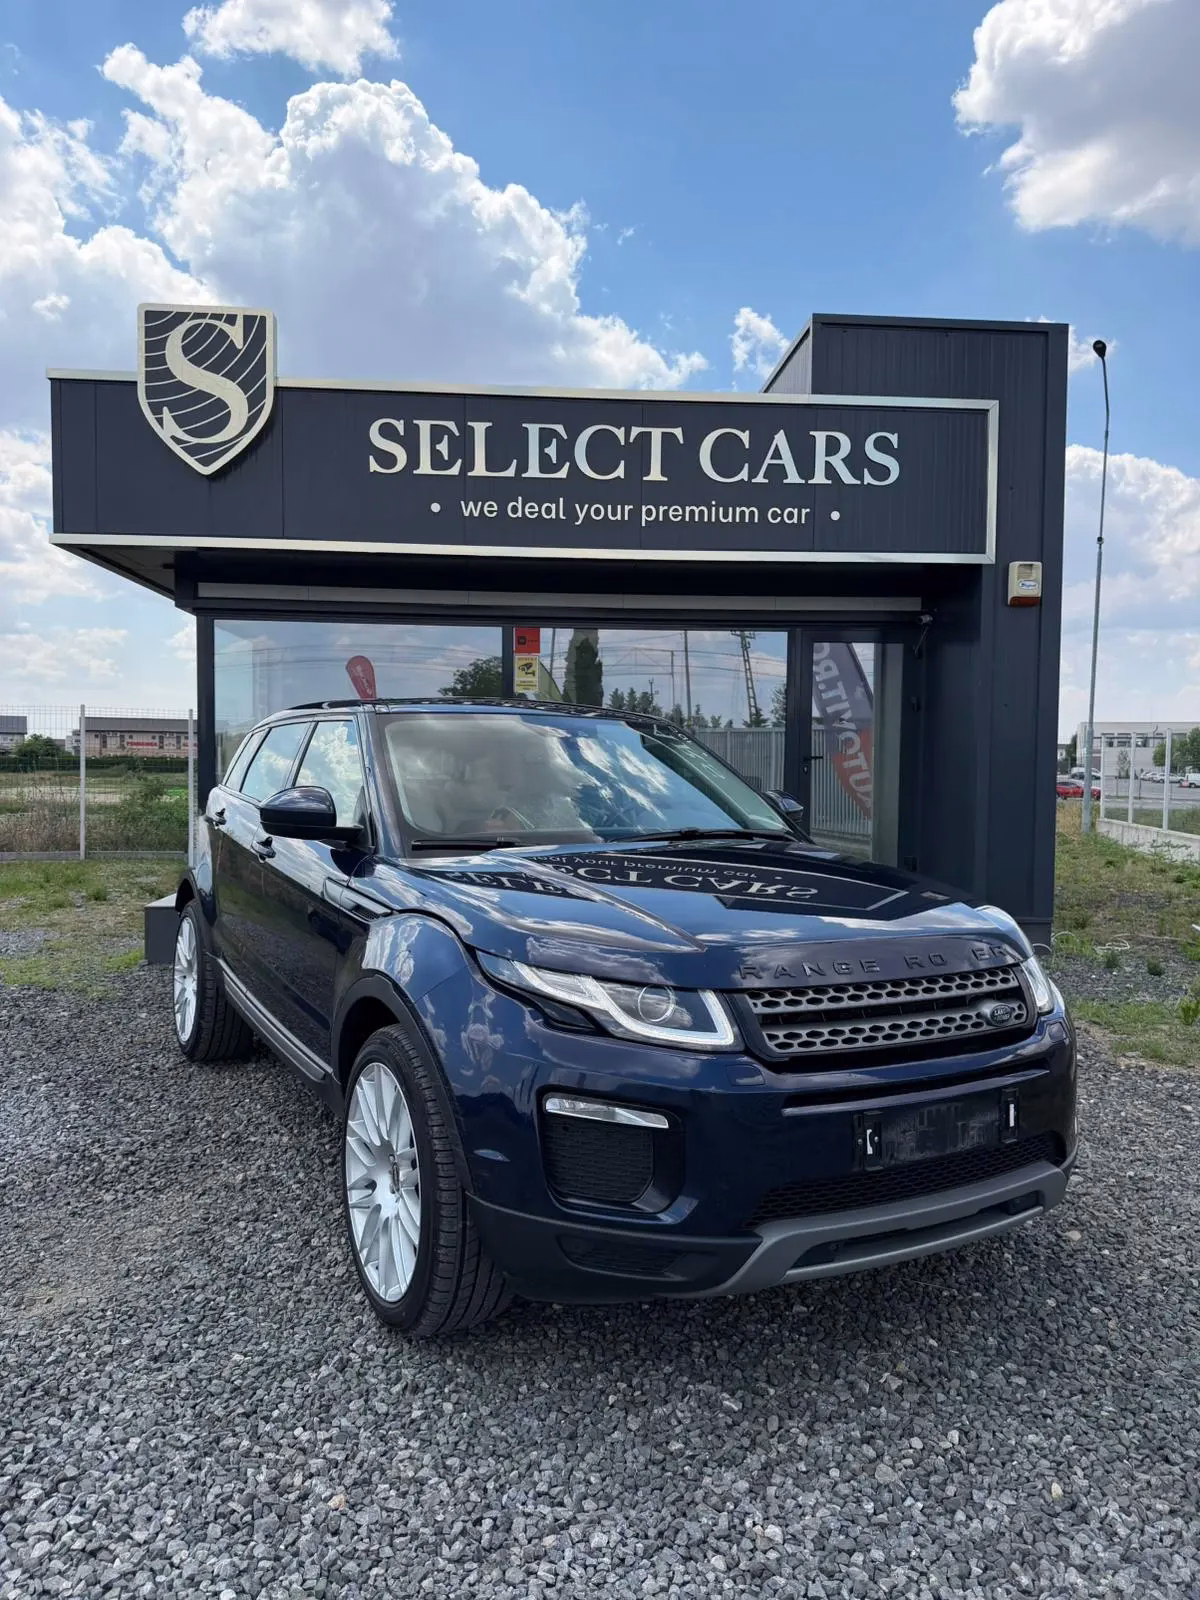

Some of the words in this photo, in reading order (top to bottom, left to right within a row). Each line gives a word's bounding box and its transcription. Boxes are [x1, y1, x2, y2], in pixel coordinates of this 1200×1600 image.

[164, 312, 249, 444] S
[369, 418, 684, 481] SELECT
[699, 427, 900, 486] CARS
[460, 500, 498, 518] we
[507, 496, 566, 520] deal
[574, 502, 634, 525] your
[641, 501, 759, 527] premium
[767, 506, 810, 524] car
[738, 959, 881, 980] RANGE
[903, 945, 1014, 970] ROER
